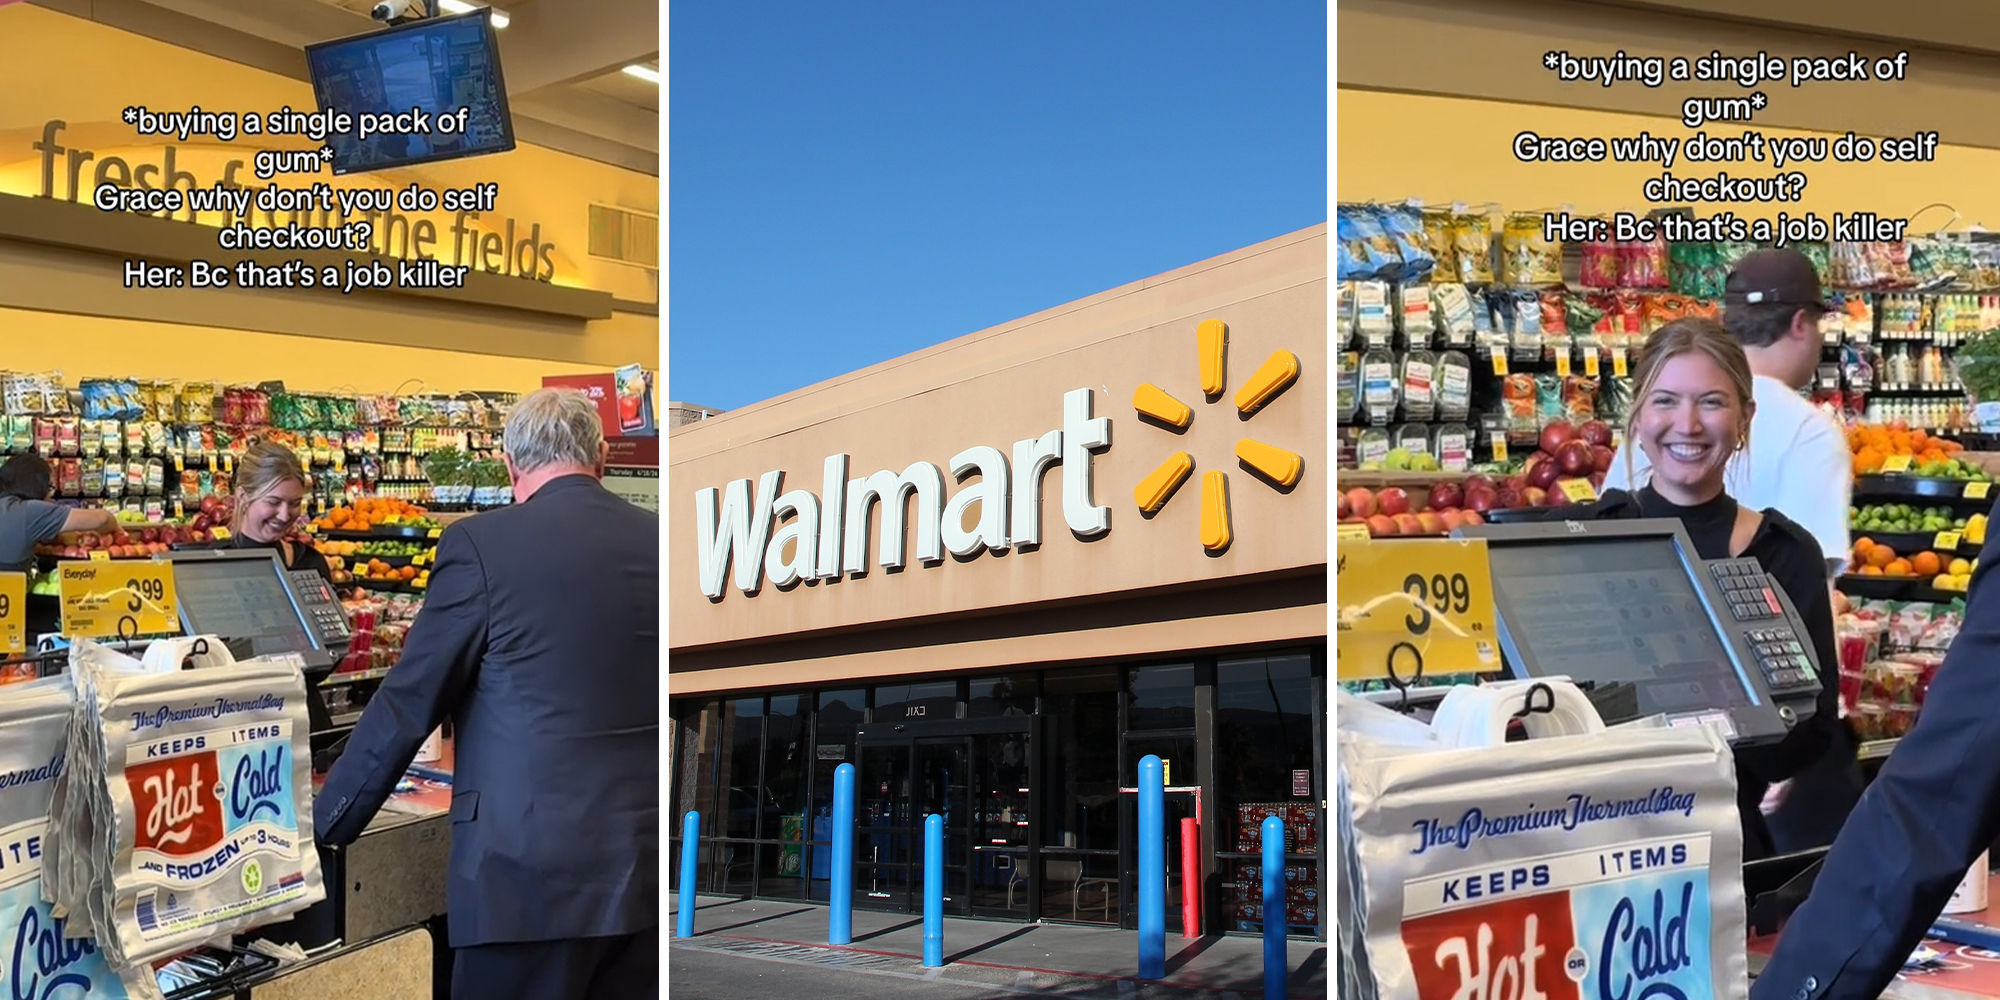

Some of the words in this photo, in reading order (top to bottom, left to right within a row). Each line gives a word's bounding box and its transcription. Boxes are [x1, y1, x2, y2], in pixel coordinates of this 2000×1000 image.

[33, 120, 196, 224] fresh
[450, 210, 556, 283] fields
[695, 387, 1111, 598] Walmart
[64, 568, 97, 581] Everyday!
[130, 711, 154, 731] The
[155, 703, 216, 728] Premium
[214, 694, 264, 719] Thermal
[262, 693, 285, 711] Bag
[147, 736, 206, 757] KEEPS
[232, 725, 281, 743] ITEMS
[143, 762, 205, 838] Hot
[231, 745, 283, 819] Cold
[1410, 819, 1456, 854] The
[1456, 804, 1567, 849] Premium
[1563, 790, 1656, 830] Thermal
[1655, 786, 1695, 816] Bag
[0, 836, 41, 870] ITE
[166, 840, 240, 880] FROZEN
[257, 829, 266, 844] 3
[1442, 865, 1550, 903] KEEPS
[1600, 844, 1687, 875] ITEMS
[1435, 914, 1548, 1000] Hot
[1568, 958, 1586, 969] OR
[1599, 881, 1693, 1000] Cold
